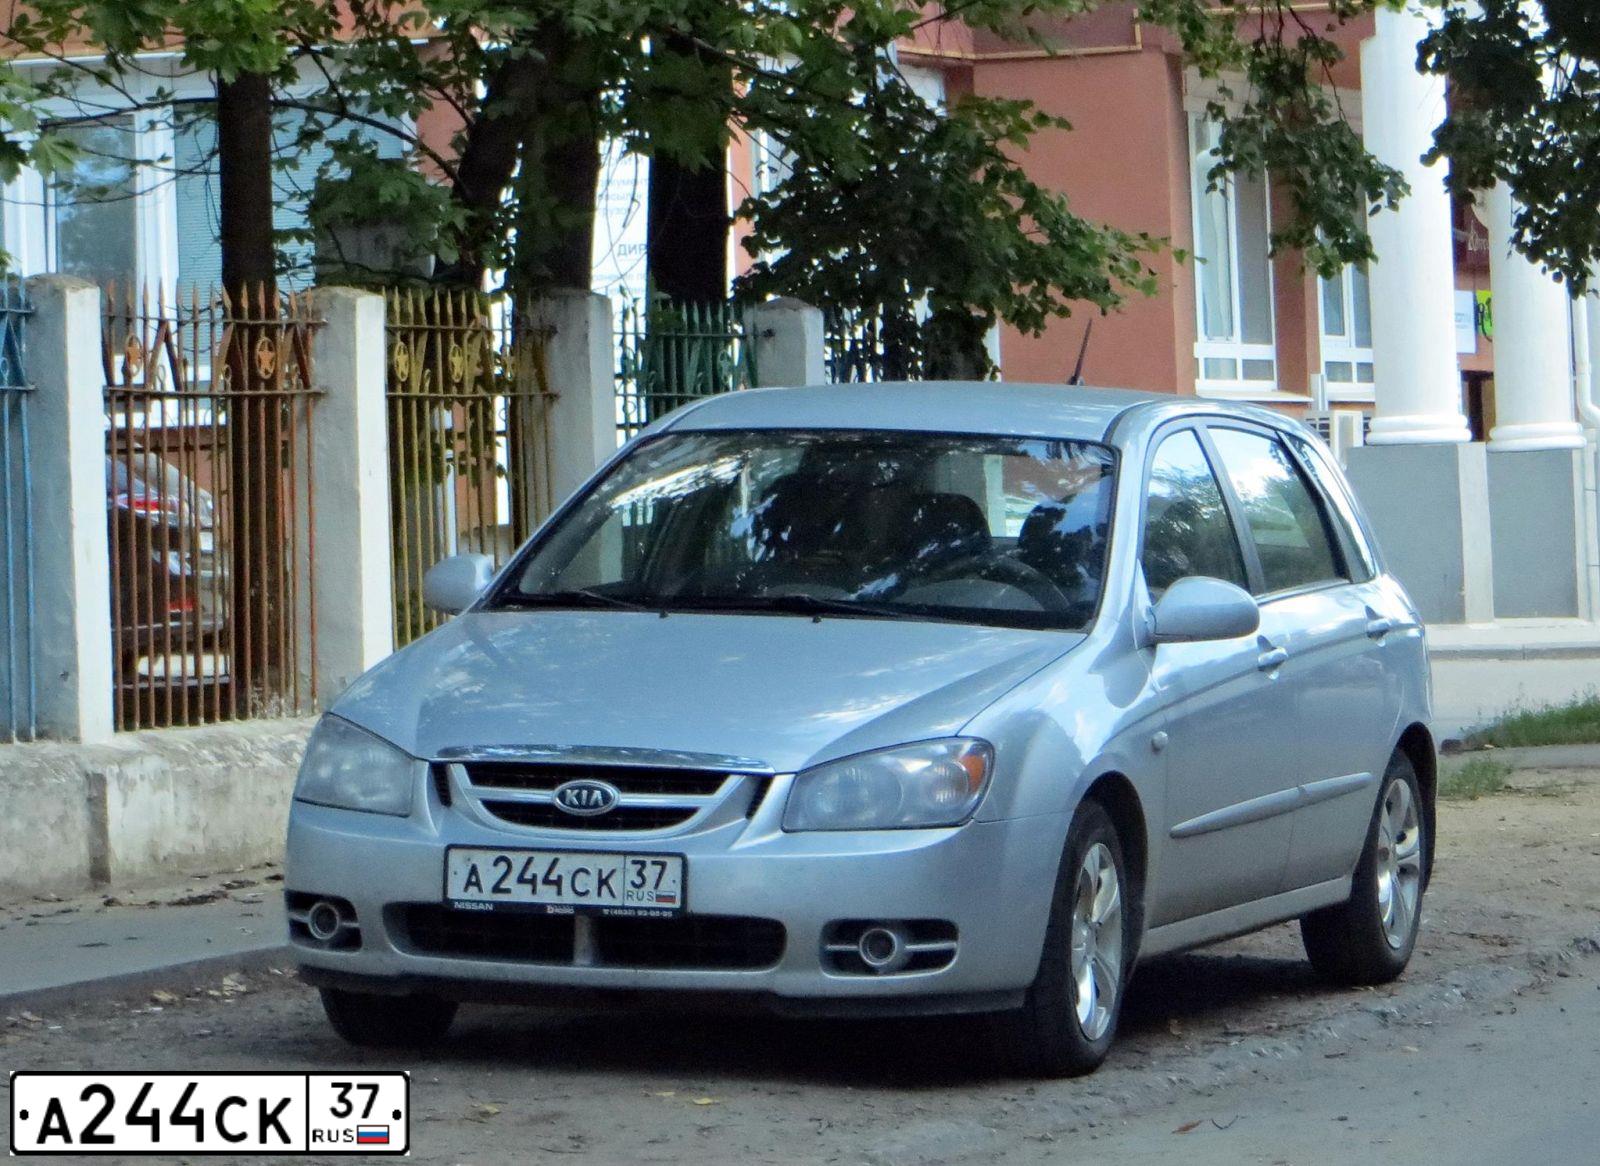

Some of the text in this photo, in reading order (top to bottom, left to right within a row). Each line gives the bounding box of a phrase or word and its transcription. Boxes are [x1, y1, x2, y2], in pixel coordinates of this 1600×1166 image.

[565, 788, 604, 806] KIA
[630, 859, 667, 890] 37
[626, 889, 654, 902] RUS
[454, 901, 494, 911] NISSAN
